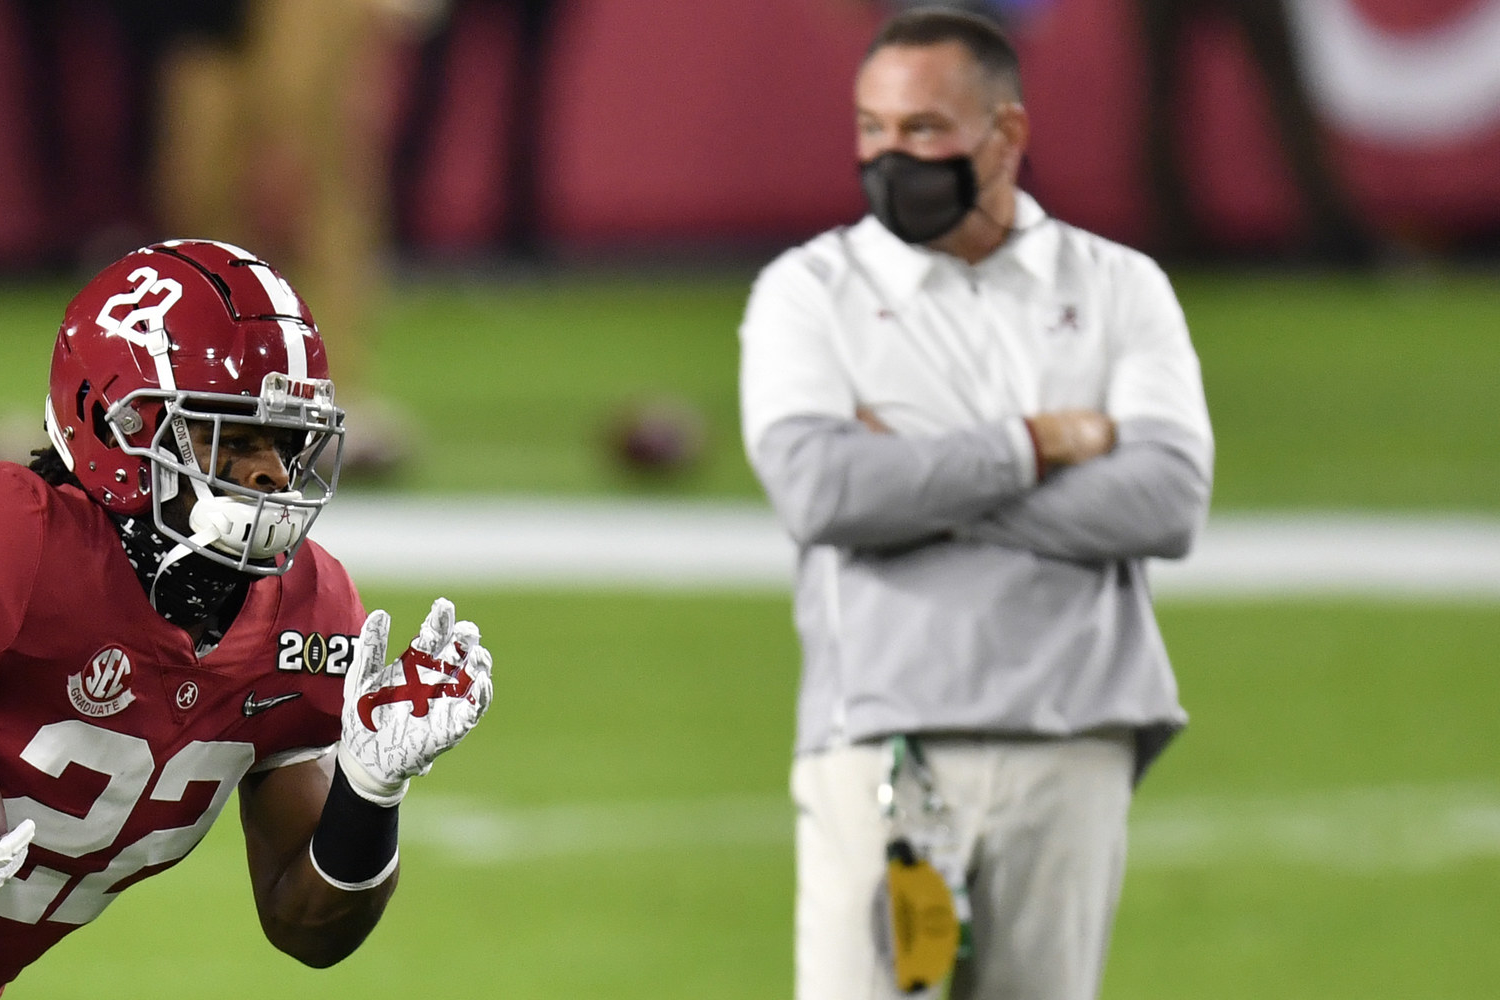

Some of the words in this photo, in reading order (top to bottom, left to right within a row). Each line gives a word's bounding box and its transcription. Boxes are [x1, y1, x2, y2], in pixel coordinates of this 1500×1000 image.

[95, 266, 183, 348] 22
[181, 442, 194, 466] TIDE
[86, 648, 131, 699] SEC
[70, 687, 120, 715] GRADUATE
